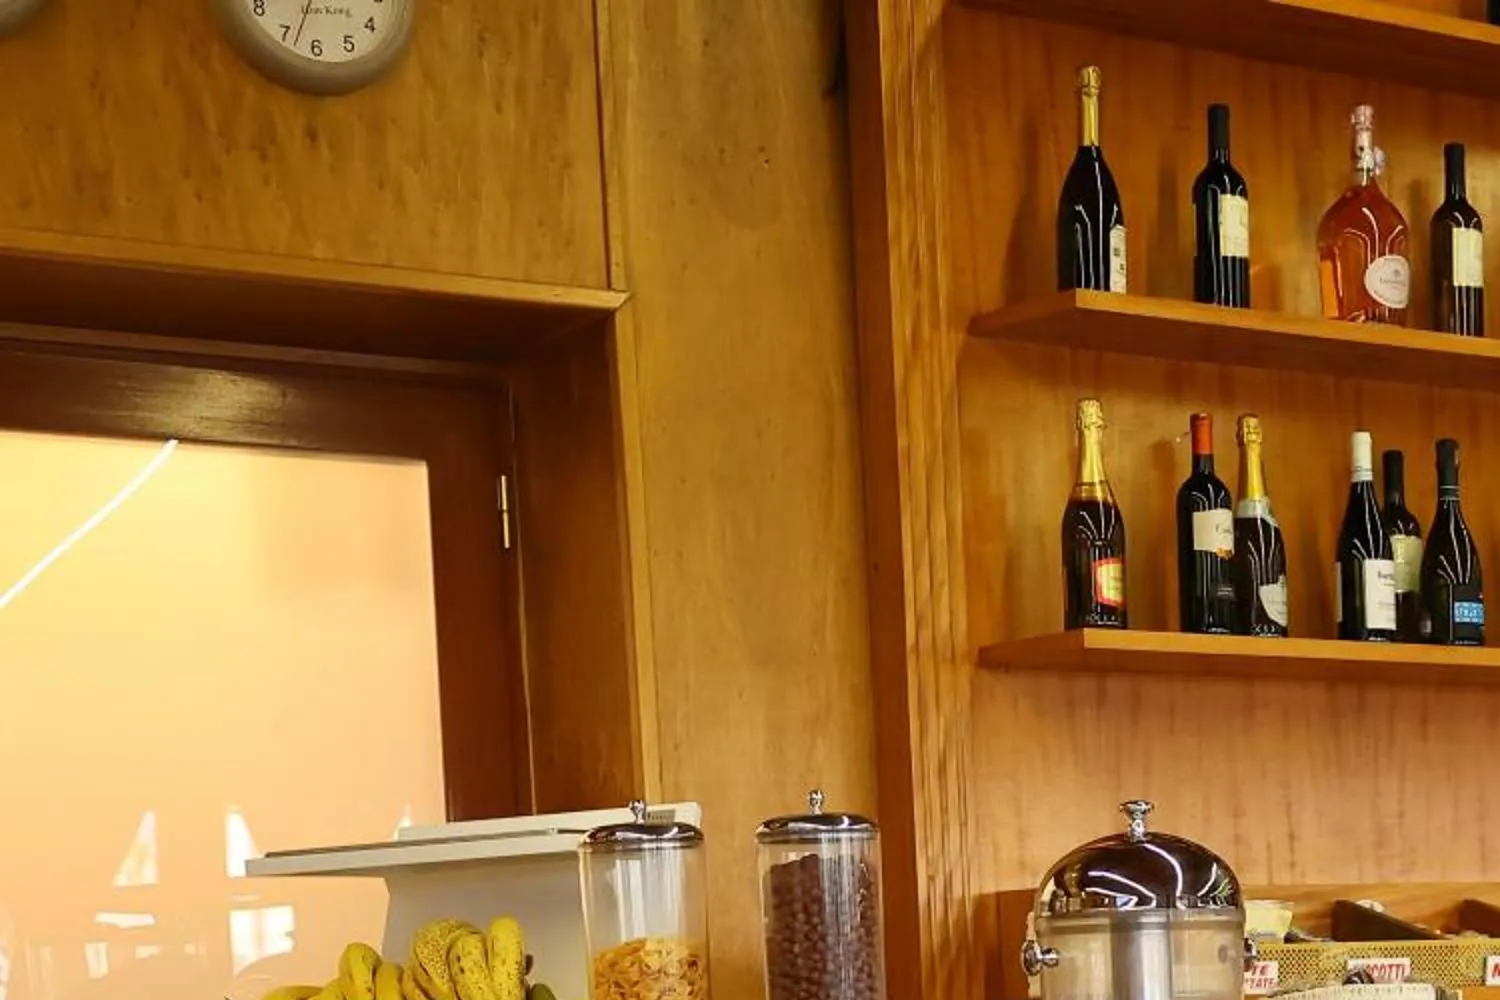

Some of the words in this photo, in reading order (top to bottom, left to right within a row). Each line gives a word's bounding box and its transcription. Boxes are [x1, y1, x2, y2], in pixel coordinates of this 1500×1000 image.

[253, 0, 265, 16] 8
[279, 23, 291, 42] 7
[364, 16, 376, 33] 4
[310, 39, 323, 57] 6
[343, 35, 355, 53] 5
